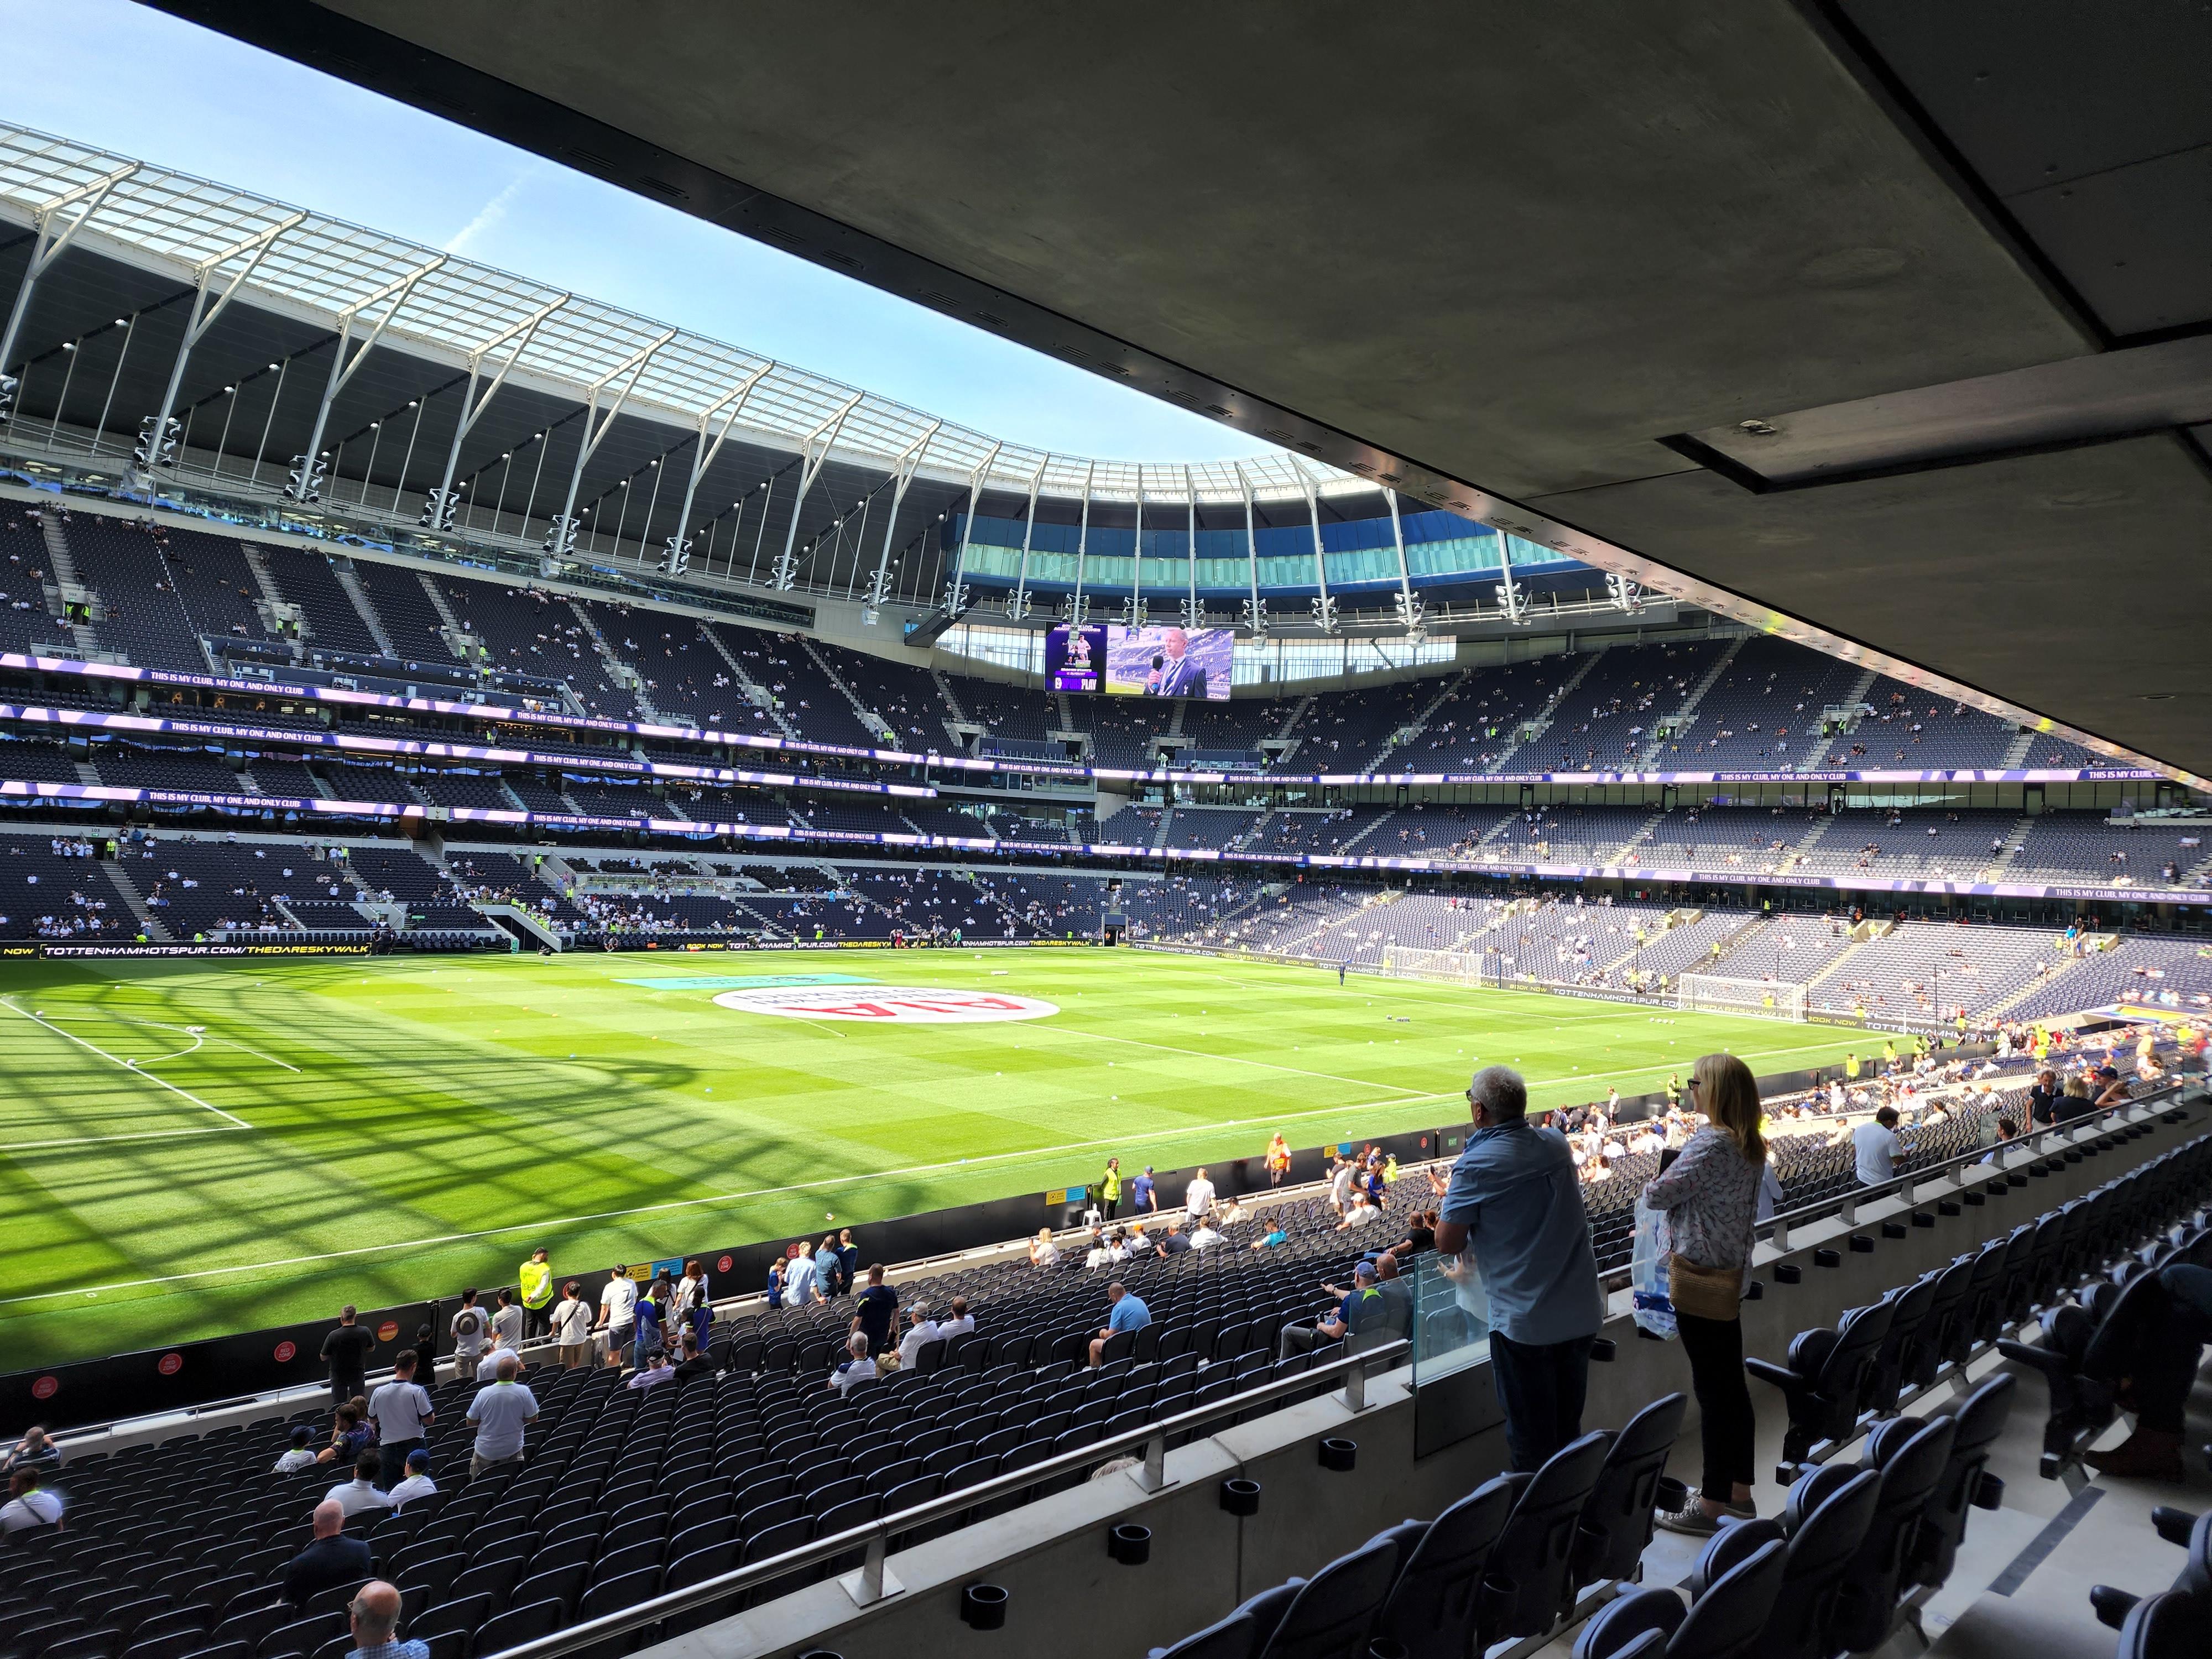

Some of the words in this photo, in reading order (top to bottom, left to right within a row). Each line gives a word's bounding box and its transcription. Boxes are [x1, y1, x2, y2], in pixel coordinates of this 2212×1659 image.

[150, 672, 168, 680] THIS
[179, 675, 190, 683] MY
[192, 676, 213, 686] CLUB,
[216, 679, 227, 687] MY
[229, 680, 244, 688] ONE
[247, 682, 262, 690] AND
[264, 684, 283, 692] ONLY
[284, 686, 304, 695] CLUB
[547, 715, 562, 723] CLUB,
[171, 722, 189, 731] THIS
[212, 726, 233, 735] CLUB,
[249, 729, 264, 737] ONE
[267, 731, 281, 739] AND
[283, 732, 303, 740] ONLY
[304, 734, 323, 743] CLUB
[563, 757, 578, 765] CLUB,
[190, 794, 211, 803] CLUB,
[2096, 890, 2117, 899] CLUB,
[773, 998, 1026, 1016] AIA
[623, 1289, 630, 1304] 7
